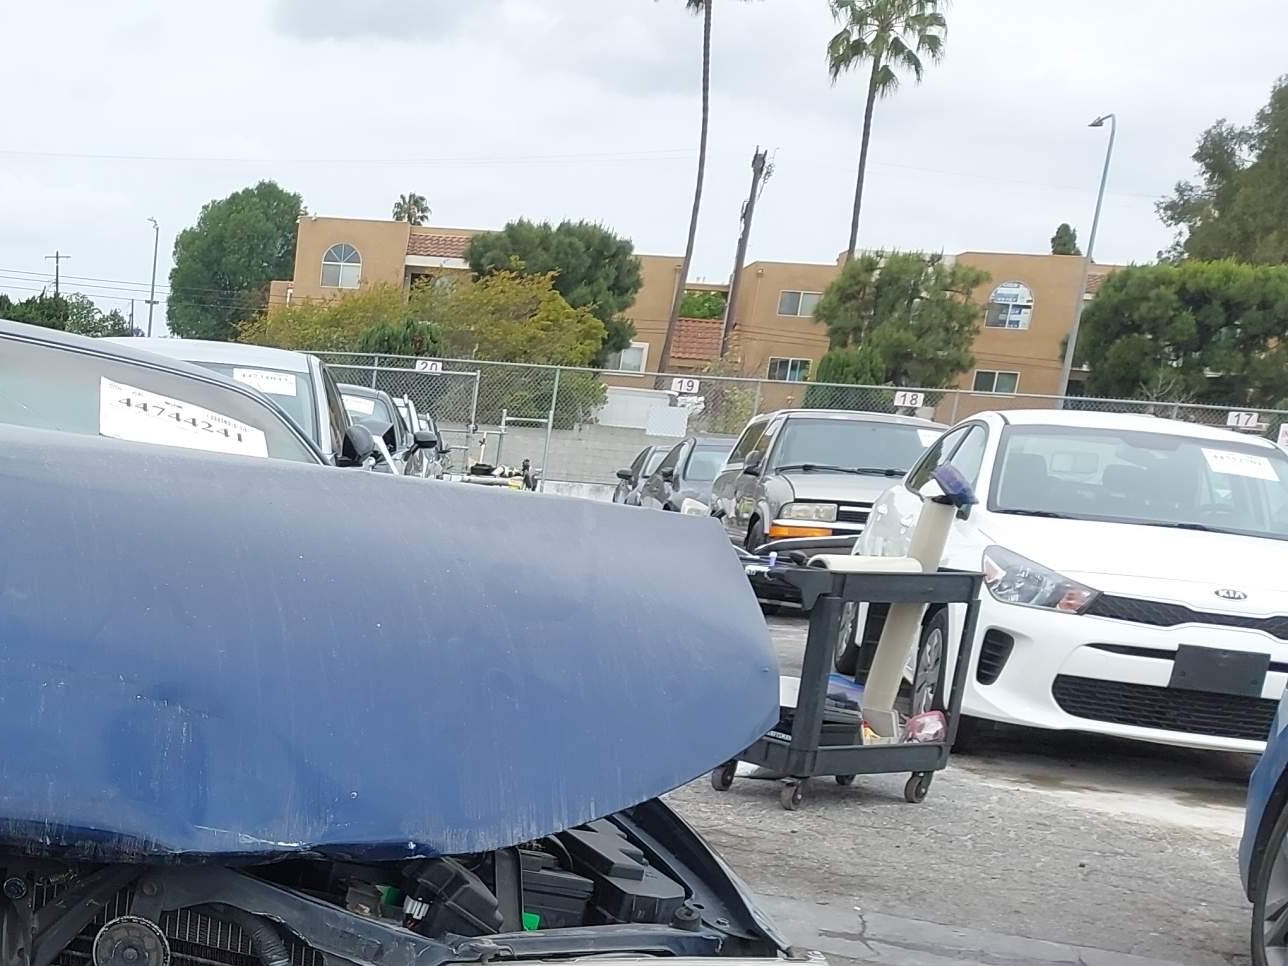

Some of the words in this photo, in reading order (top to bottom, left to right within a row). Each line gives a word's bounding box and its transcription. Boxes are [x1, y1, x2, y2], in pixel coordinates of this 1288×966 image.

[677, 379, 696, 392] 19
[900, 392, 919, 406] 18
[117, 397, 243, 443] 44744241
[1234, 412, 1254, 426] 17
[1218, 588, 1246, 600] KIA
